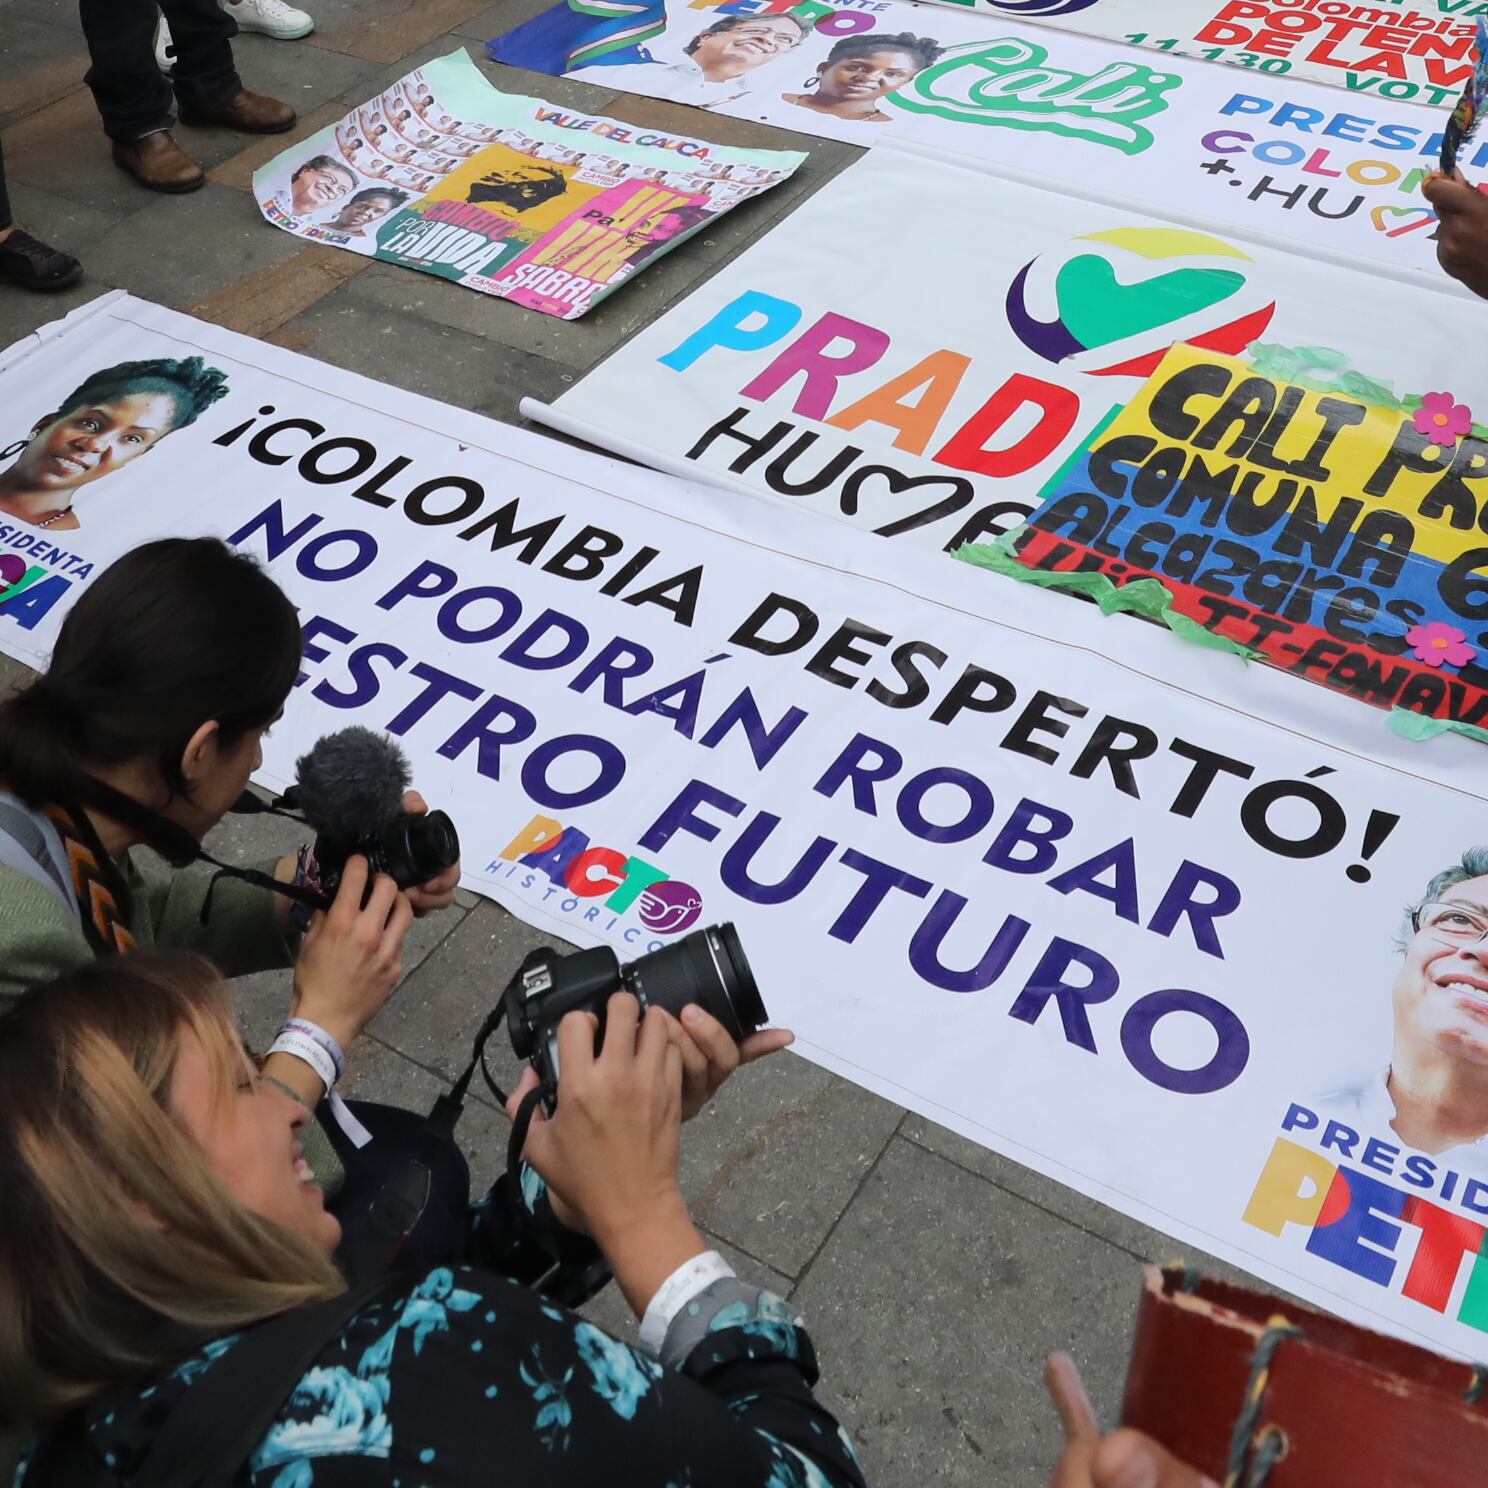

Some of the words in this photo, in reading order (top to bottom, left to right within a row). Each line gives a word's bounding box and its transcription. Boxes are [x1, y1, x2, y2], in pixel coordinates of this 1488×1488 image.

[883, 37, 1184, 156] Cali
[1193, 19, 1305, 58] DE
[1304, 39, 1408, 80] LA
[535, 107, 598, 131] VALLE
[592, 122, 633, 145] DEL
[634, 134, 712, 161] CAUCA
[581, 171, 621, 185] CAMBIO
[379, 231, 420, 254] LA
[404, 221, 509, 276] VIDA
[395, 217, 436, 236] POR
[469, 275, 511, 293] CAMBIO
[655, 289, 1124, 500] PRAD
[1149, 363, 1367, 482] CALI
[1087, 434, 1417, 589] COMUNA
[212, 405, 704, 628] ¡COLOMBIA
[728, 591, 1402, 884] DESPERTÓ!
[226, 497, 379, 583] NO
[375, 559, 809, 772] PODRÁN
[812, 731, 1242, 961] ROBAR
[283, 615, 627, 811] ESTRO
[637, 777, 1250, 1096] FUTURO
[484, 859, 666, 954] HISTÓRICO
[498, 814, 704, 935] PACTO
